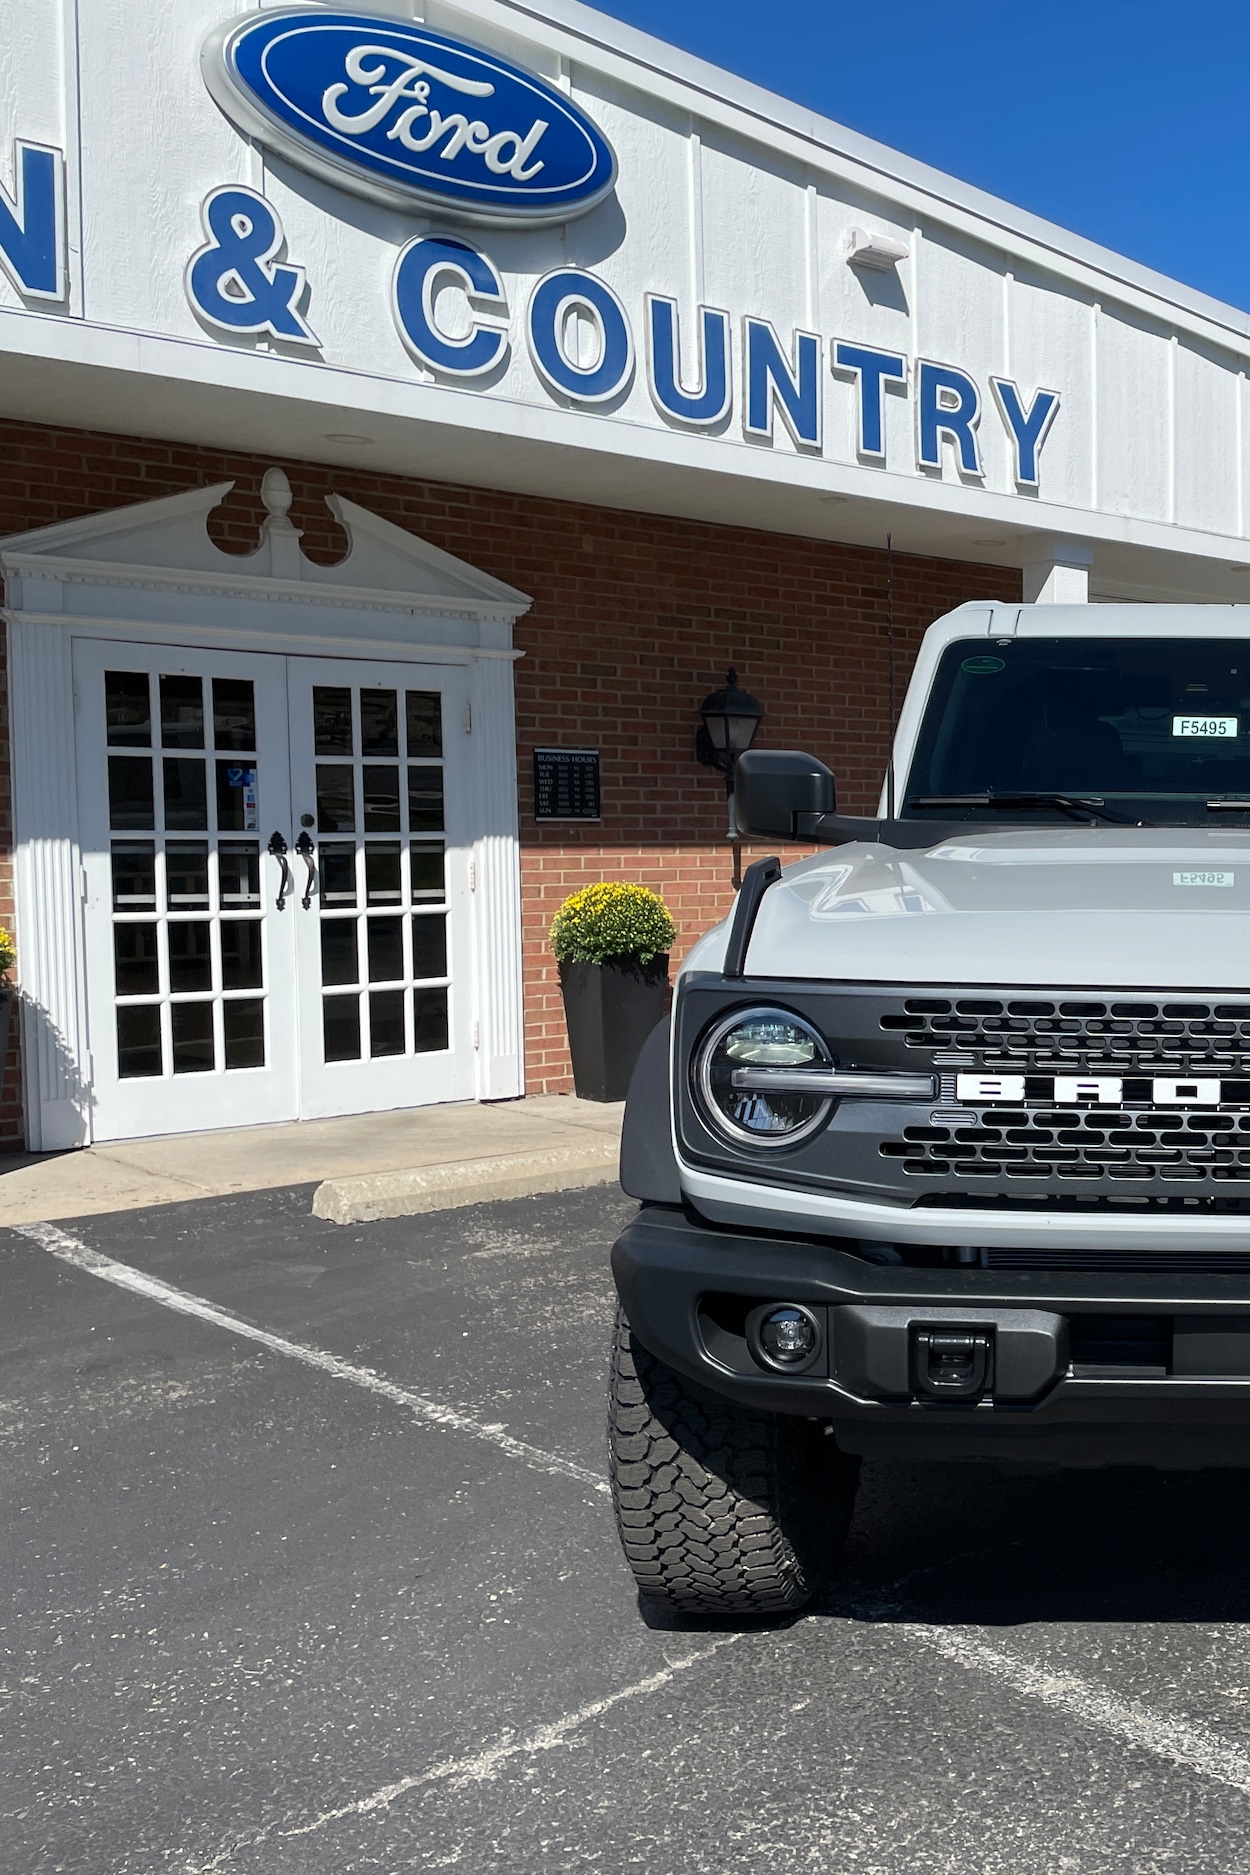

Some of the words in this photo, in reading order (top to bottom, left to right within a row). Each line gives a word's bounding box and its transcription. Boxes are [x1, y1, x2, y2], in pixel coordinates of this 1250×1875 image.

[322, 44, 548, 182] Ford
[184, 184, 323, 348] &
[391, 232, 1061, 487] COUNTRY
[571, 755, 597, 763] HOURS
[1181, 720, 1227, 735] F5495
